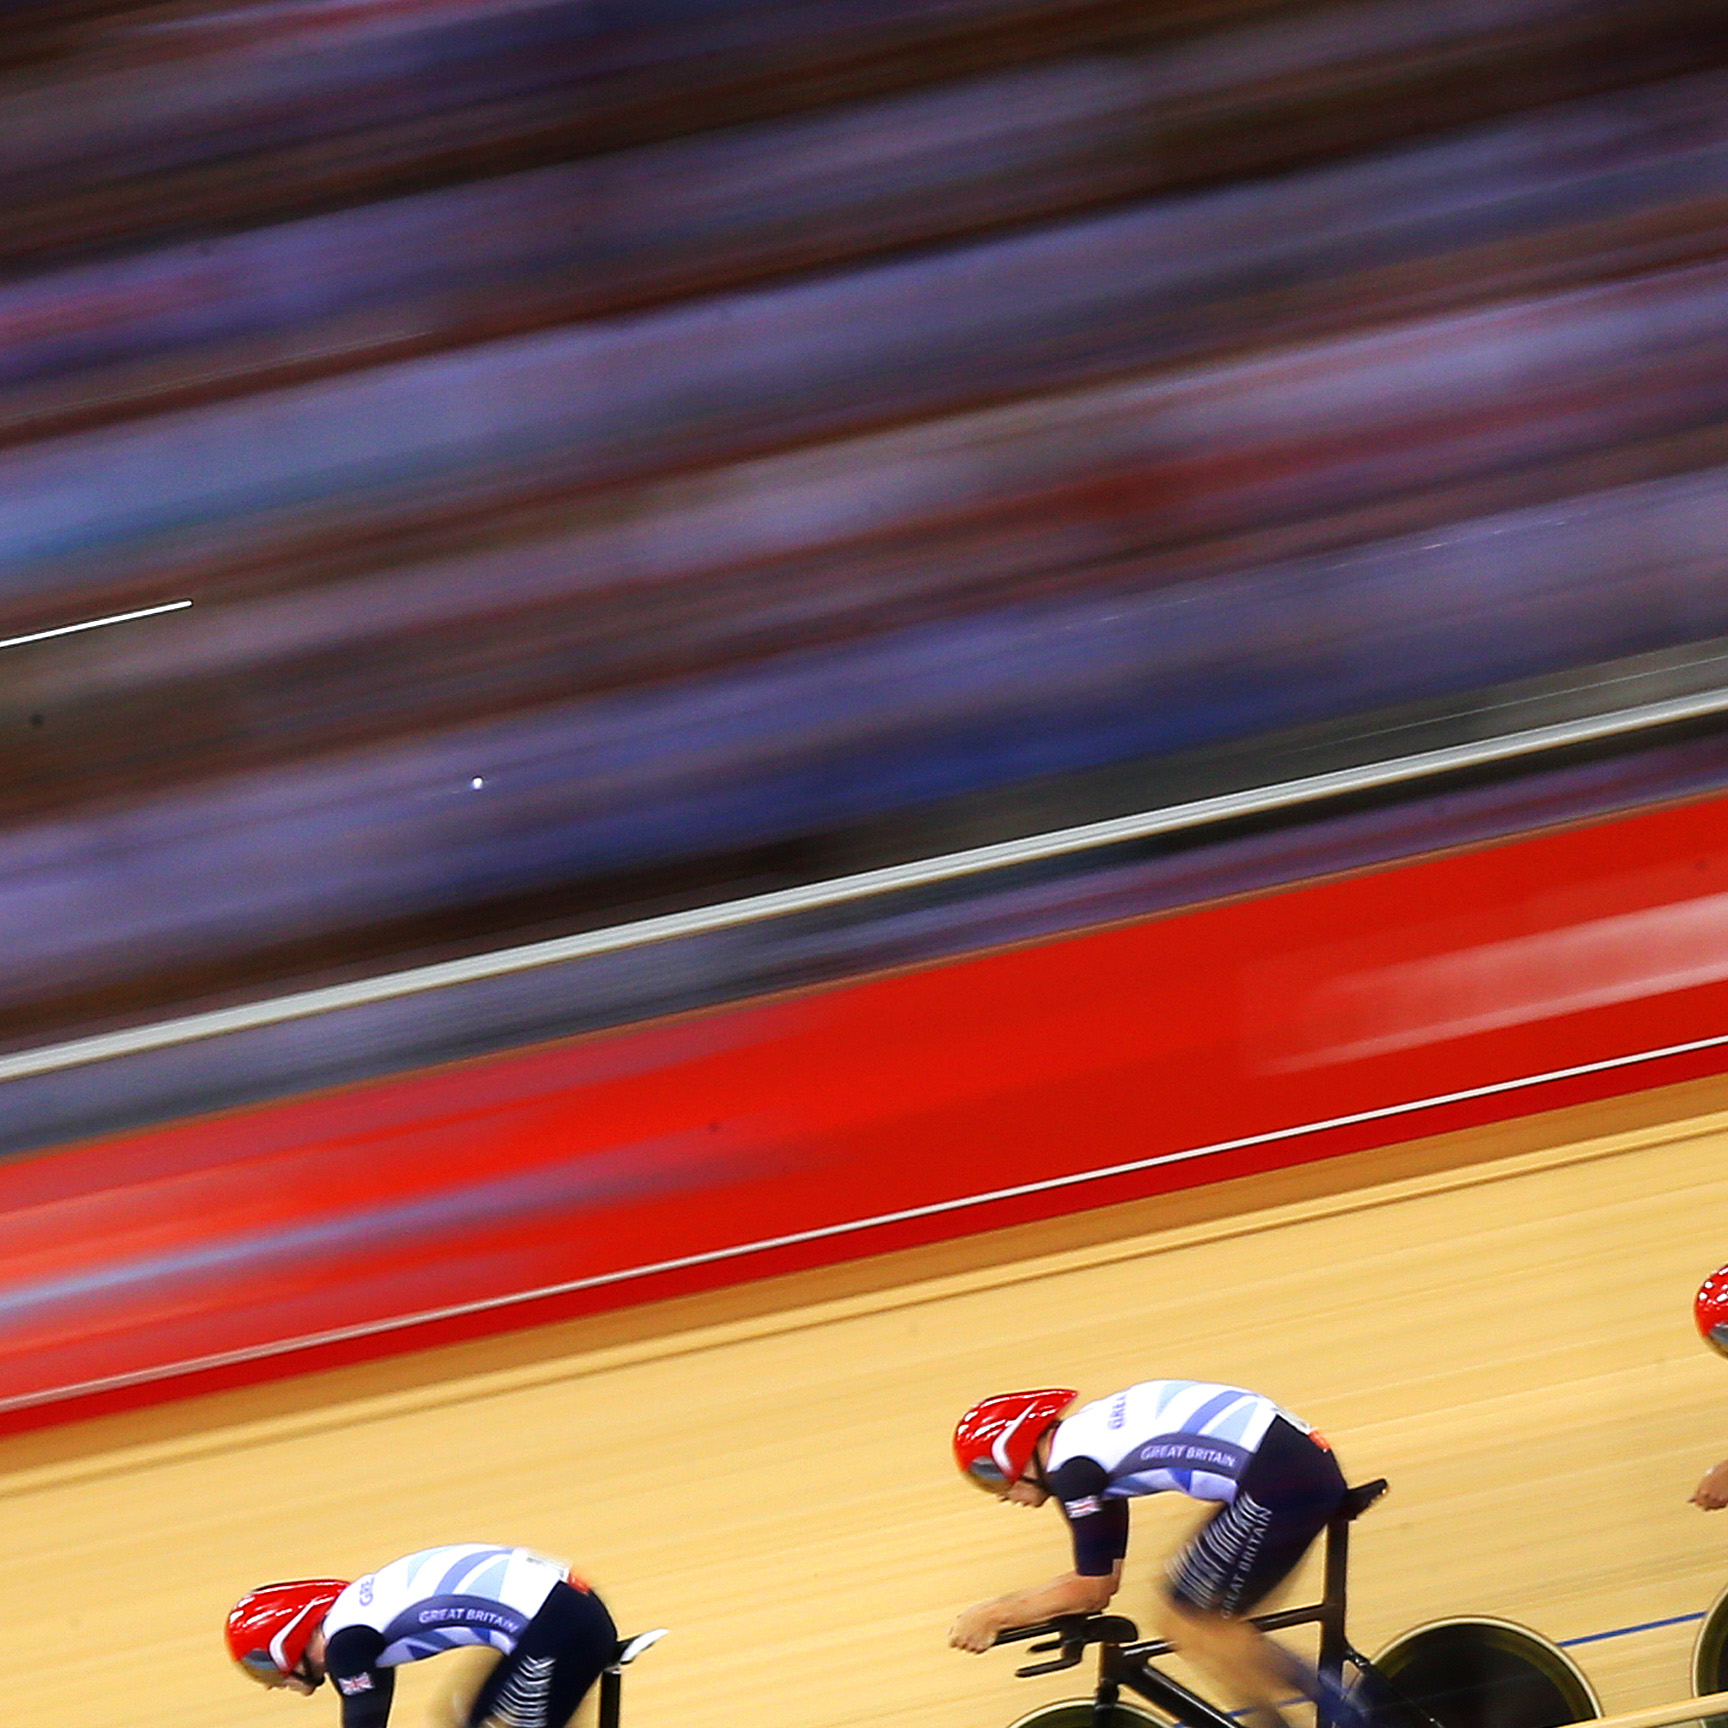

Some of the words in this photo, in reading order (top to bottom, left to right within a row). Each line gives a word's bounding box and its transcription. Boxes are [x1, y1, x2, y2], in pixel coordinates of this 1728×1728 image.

[1140, 1443, 1187, 1461] GREAT
[1186, 1445, 1237, 1468] BRITAIN
[418, 1607, 465, 1624] GREAT
[465, 1608, 520, 1634] BRITAIN
